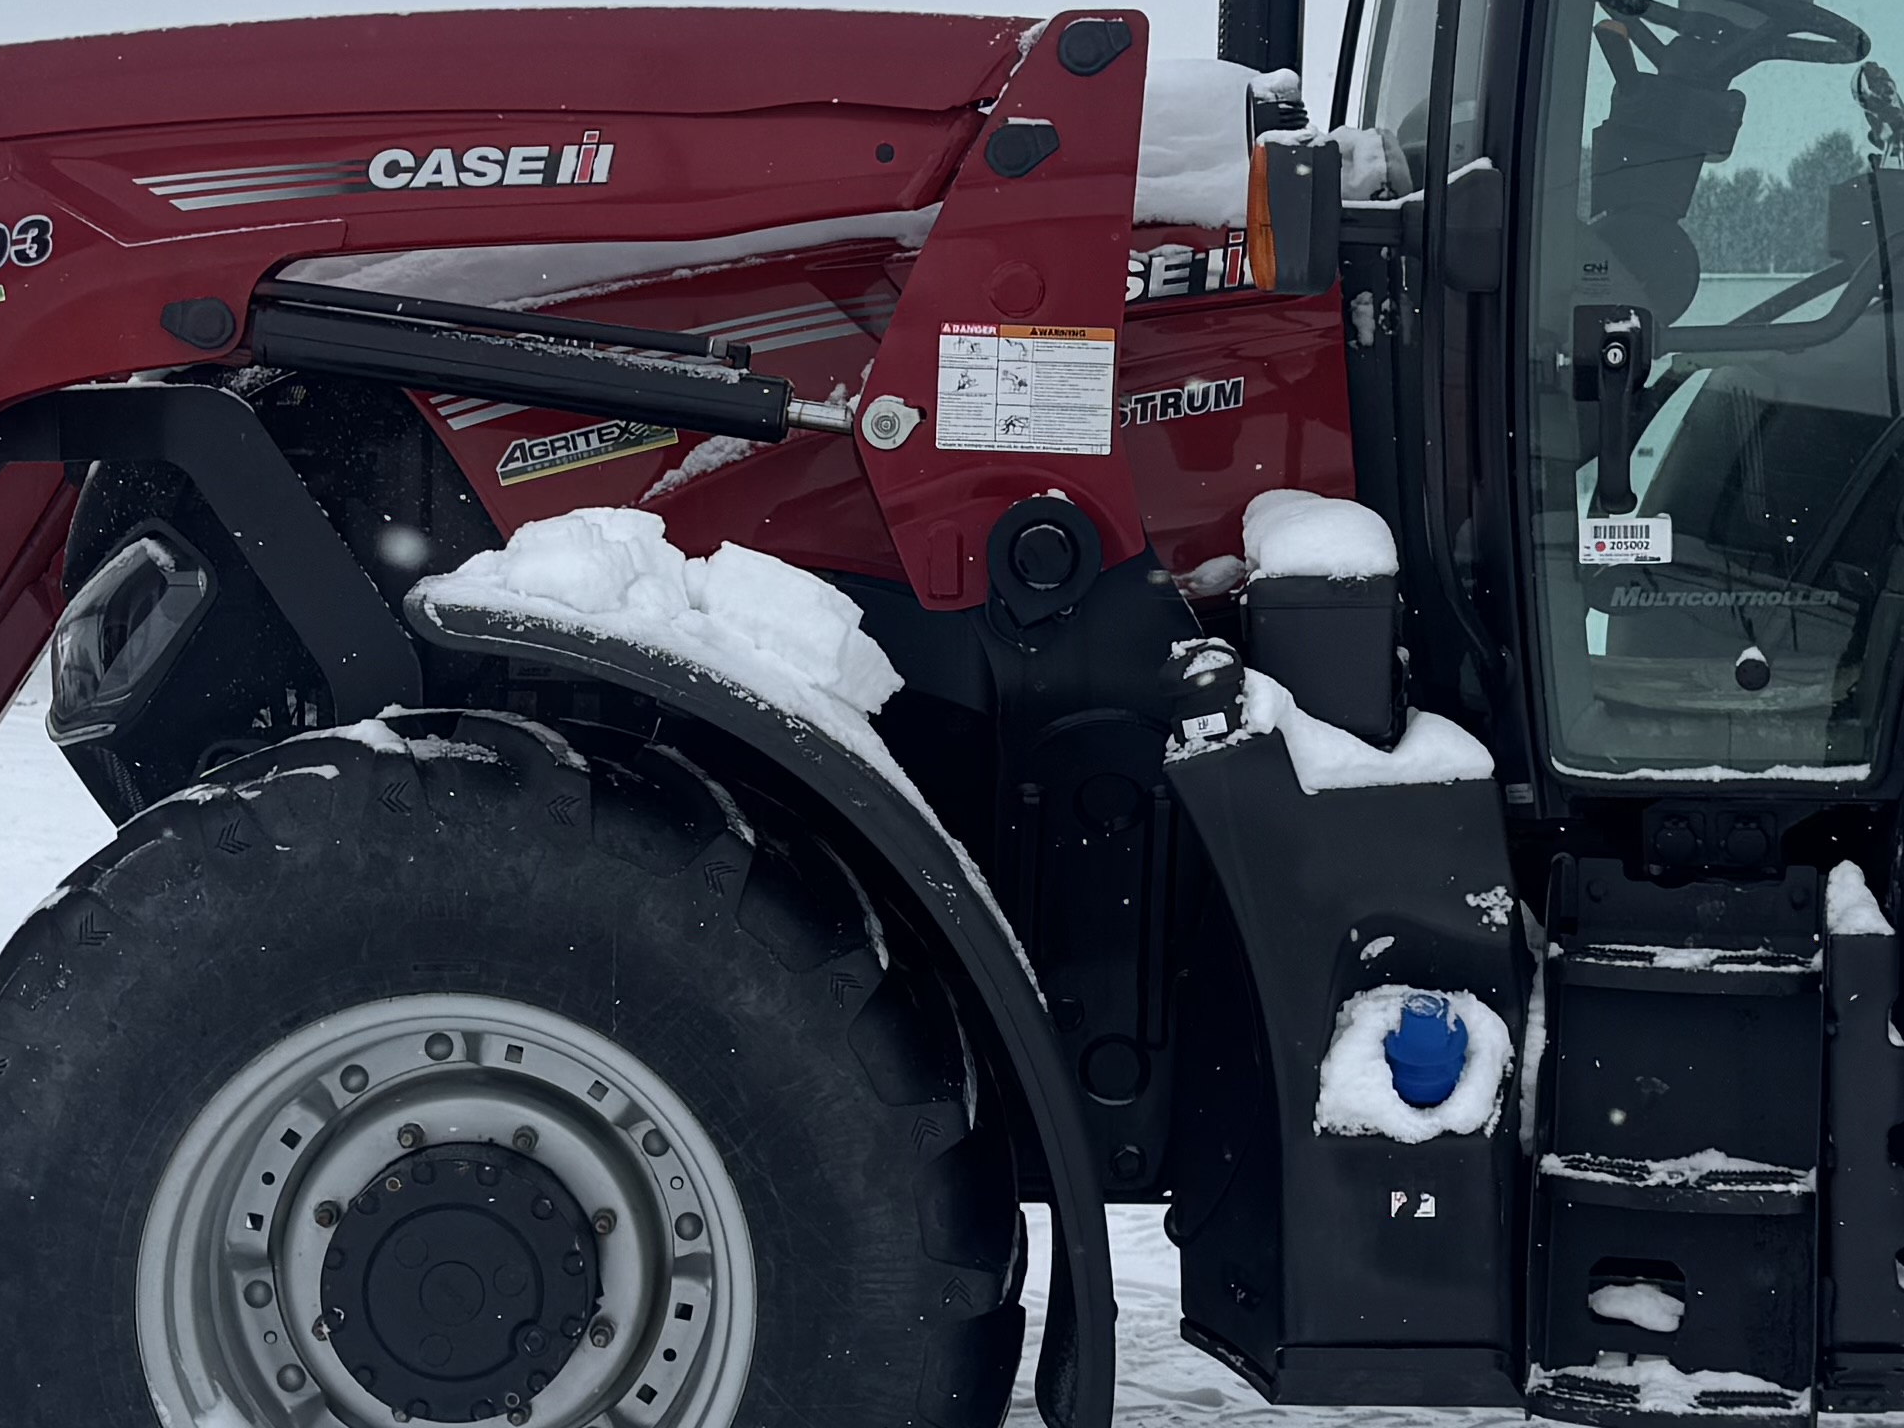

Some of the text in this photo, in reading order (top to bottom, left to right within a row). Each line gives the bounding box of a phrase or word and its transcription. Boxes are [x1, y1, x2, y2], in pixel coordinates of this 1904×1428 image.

[368, 146, 550, 189] CASE
[952, 323, 997, 335] DANGER
[1038, 328, 1087, 338] WARNING
[499, 421, 637, 469] AGRITEX
